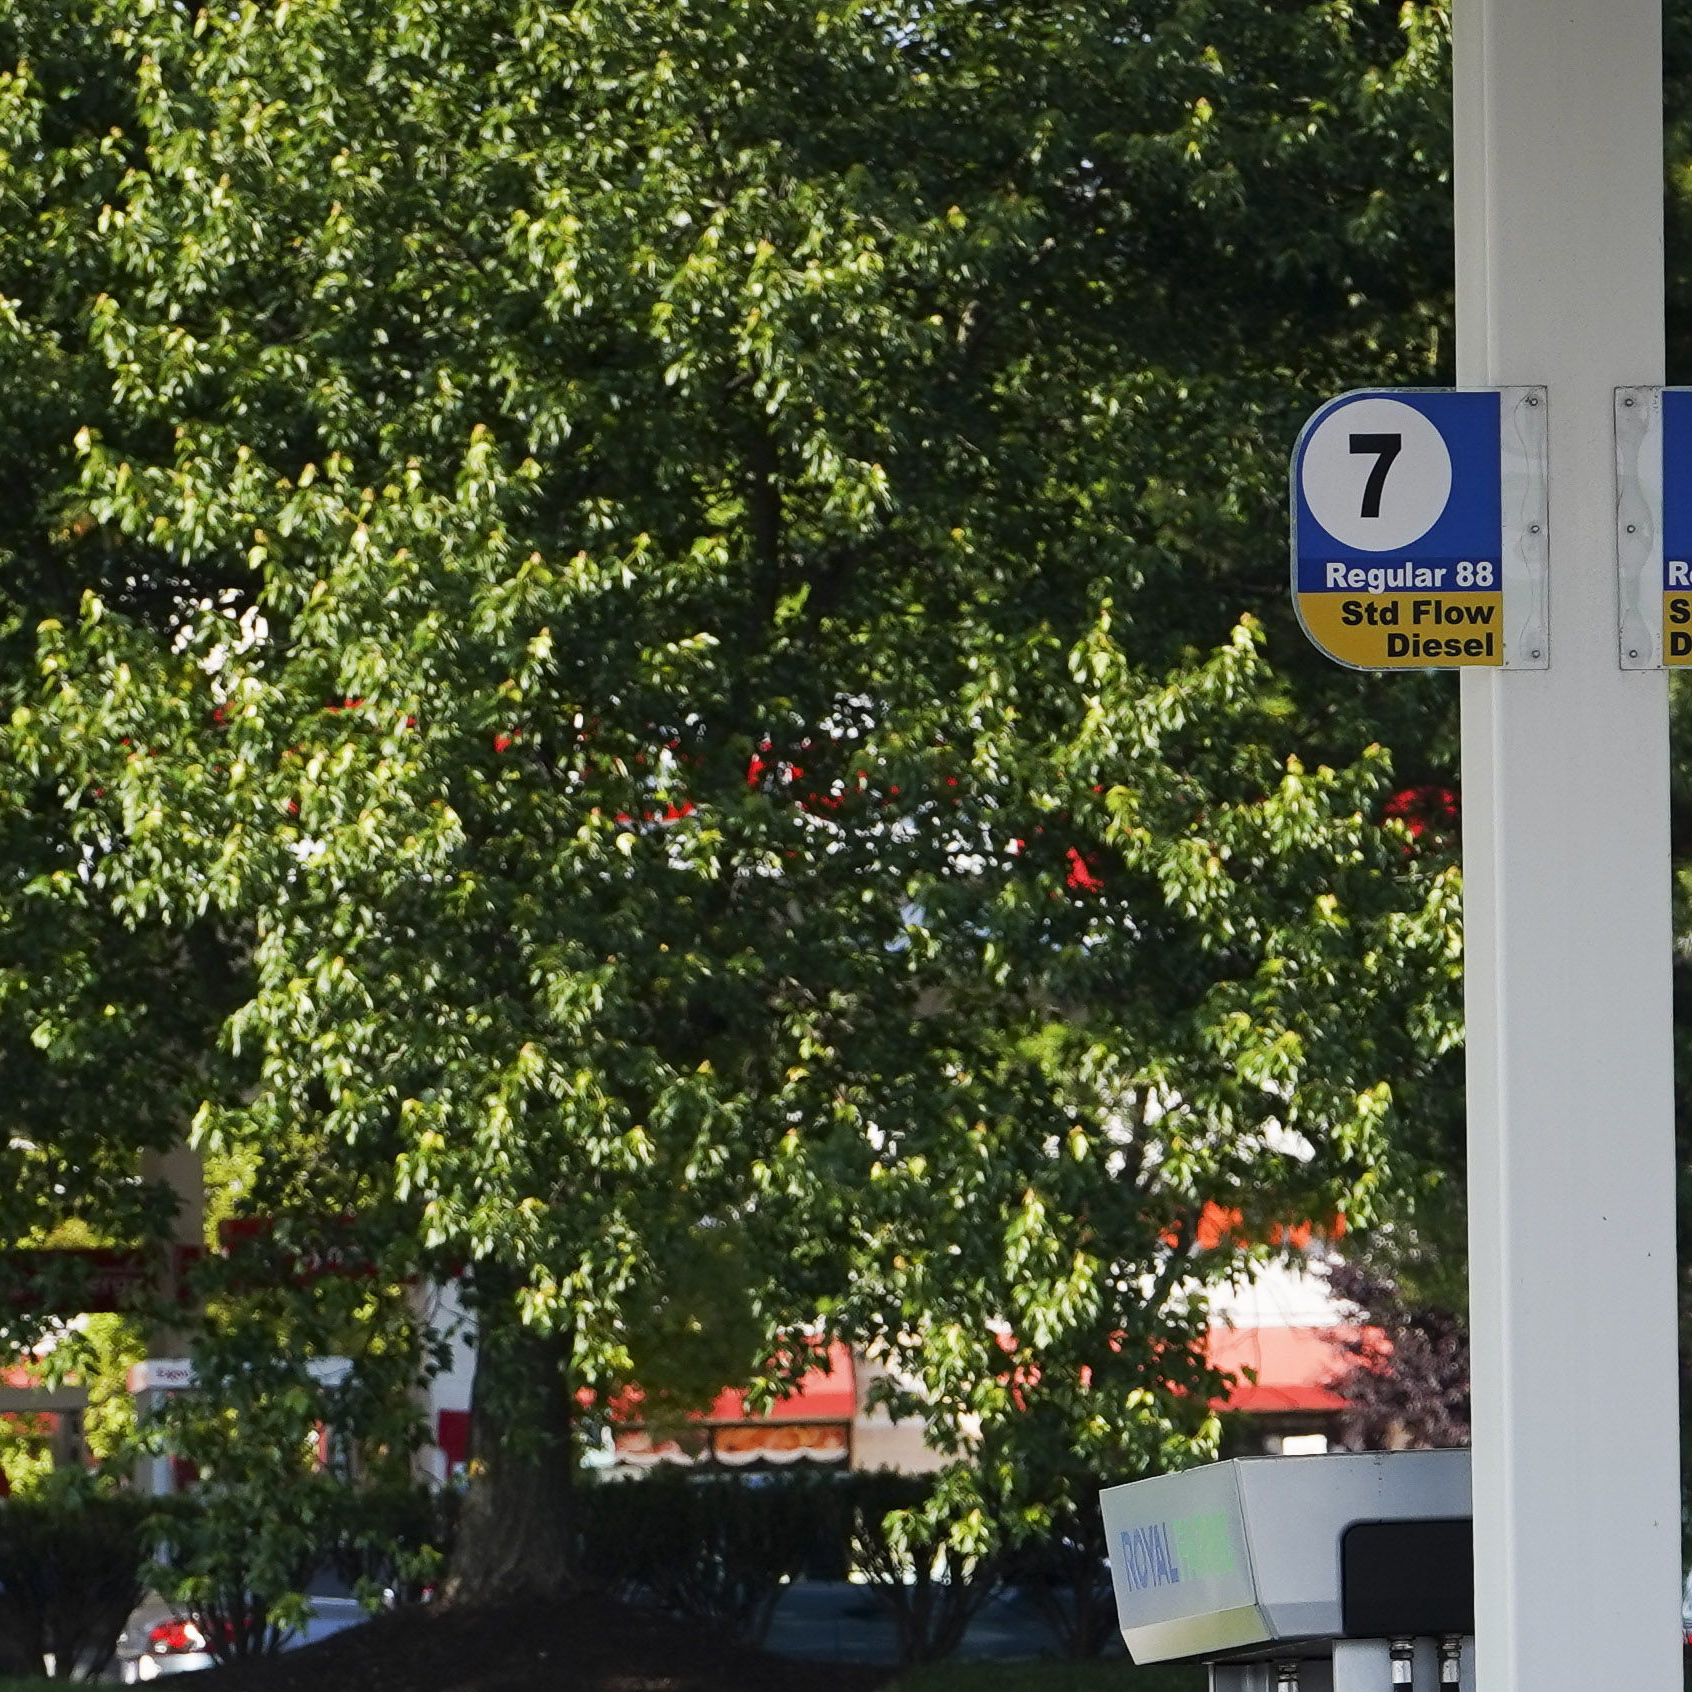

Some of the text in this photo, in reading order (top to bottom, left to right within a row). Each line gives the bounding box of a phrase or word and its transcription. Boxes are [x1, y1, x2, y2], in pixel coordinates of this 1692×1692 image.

[1349, 433, 1402, 518] 7
[1325, 562, 1495, 594] Regular 88
[1341, 600, 1495, 626] Std Flow
[1386, 632, 1495, 658] Diesel
[1121, 1522, 1179, 1592] ROYAL
